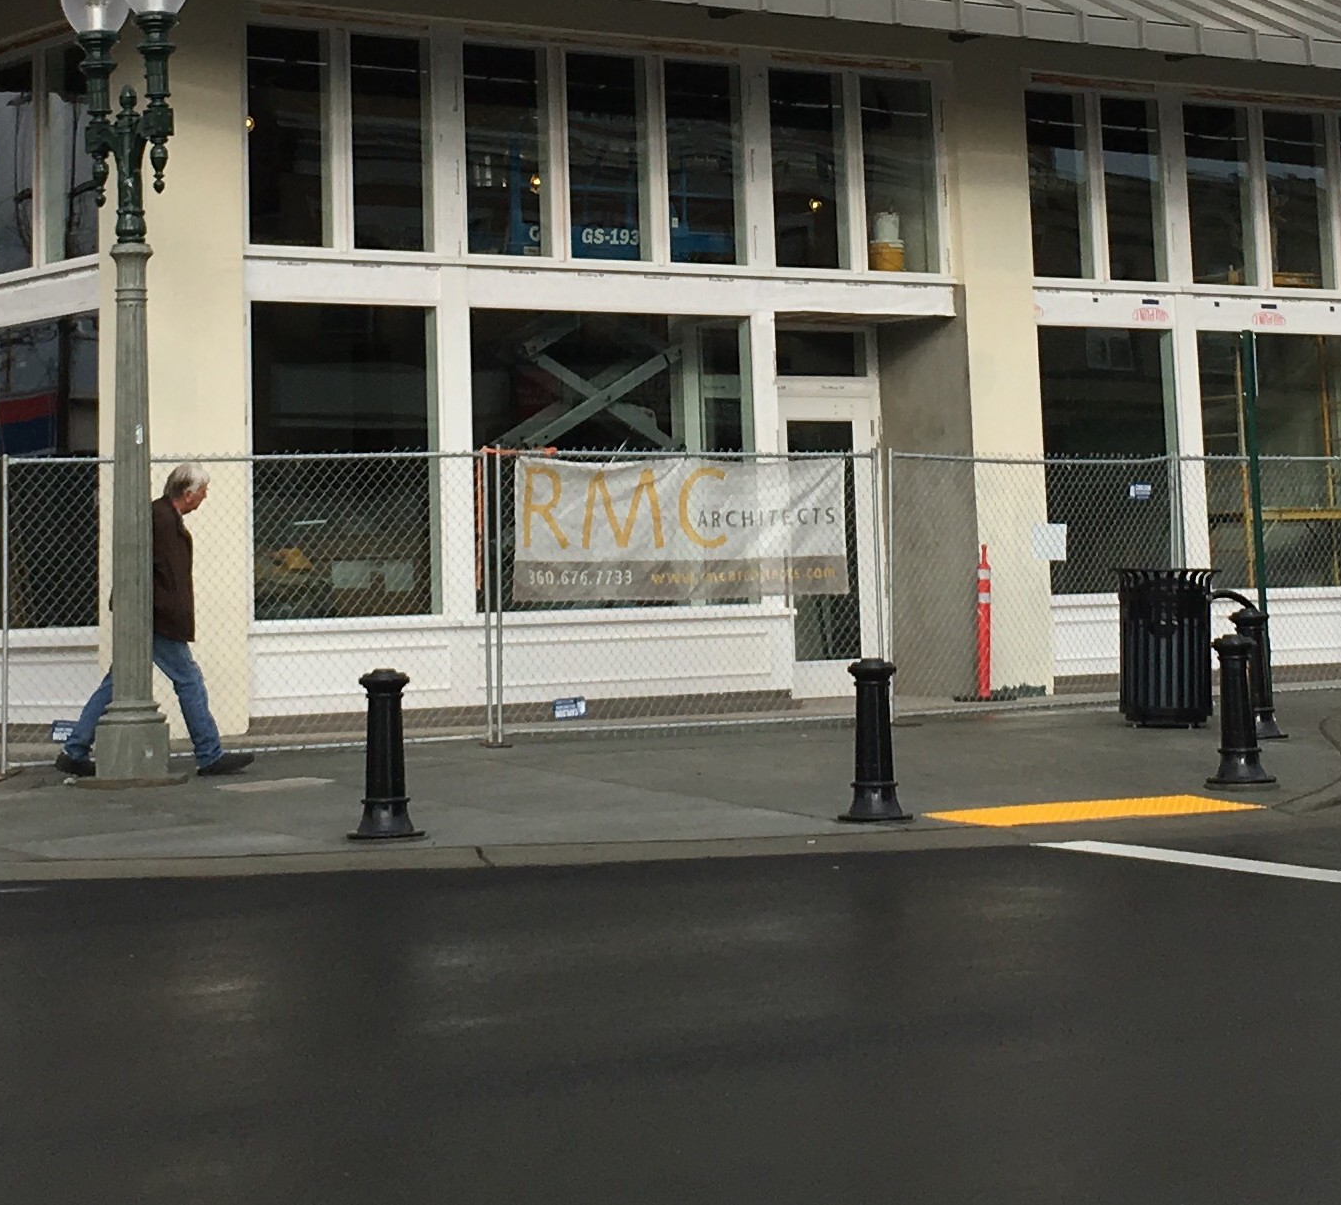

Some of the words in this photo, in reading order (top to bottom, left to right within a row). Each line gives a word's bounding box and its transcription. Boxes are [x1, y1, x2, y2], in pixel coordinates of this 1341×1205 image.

[523, 467, 728, 549] RMC
[697, 507, 836, 528] ARCHITECTS
[528, 568, 634, 586] 360.676.7733
